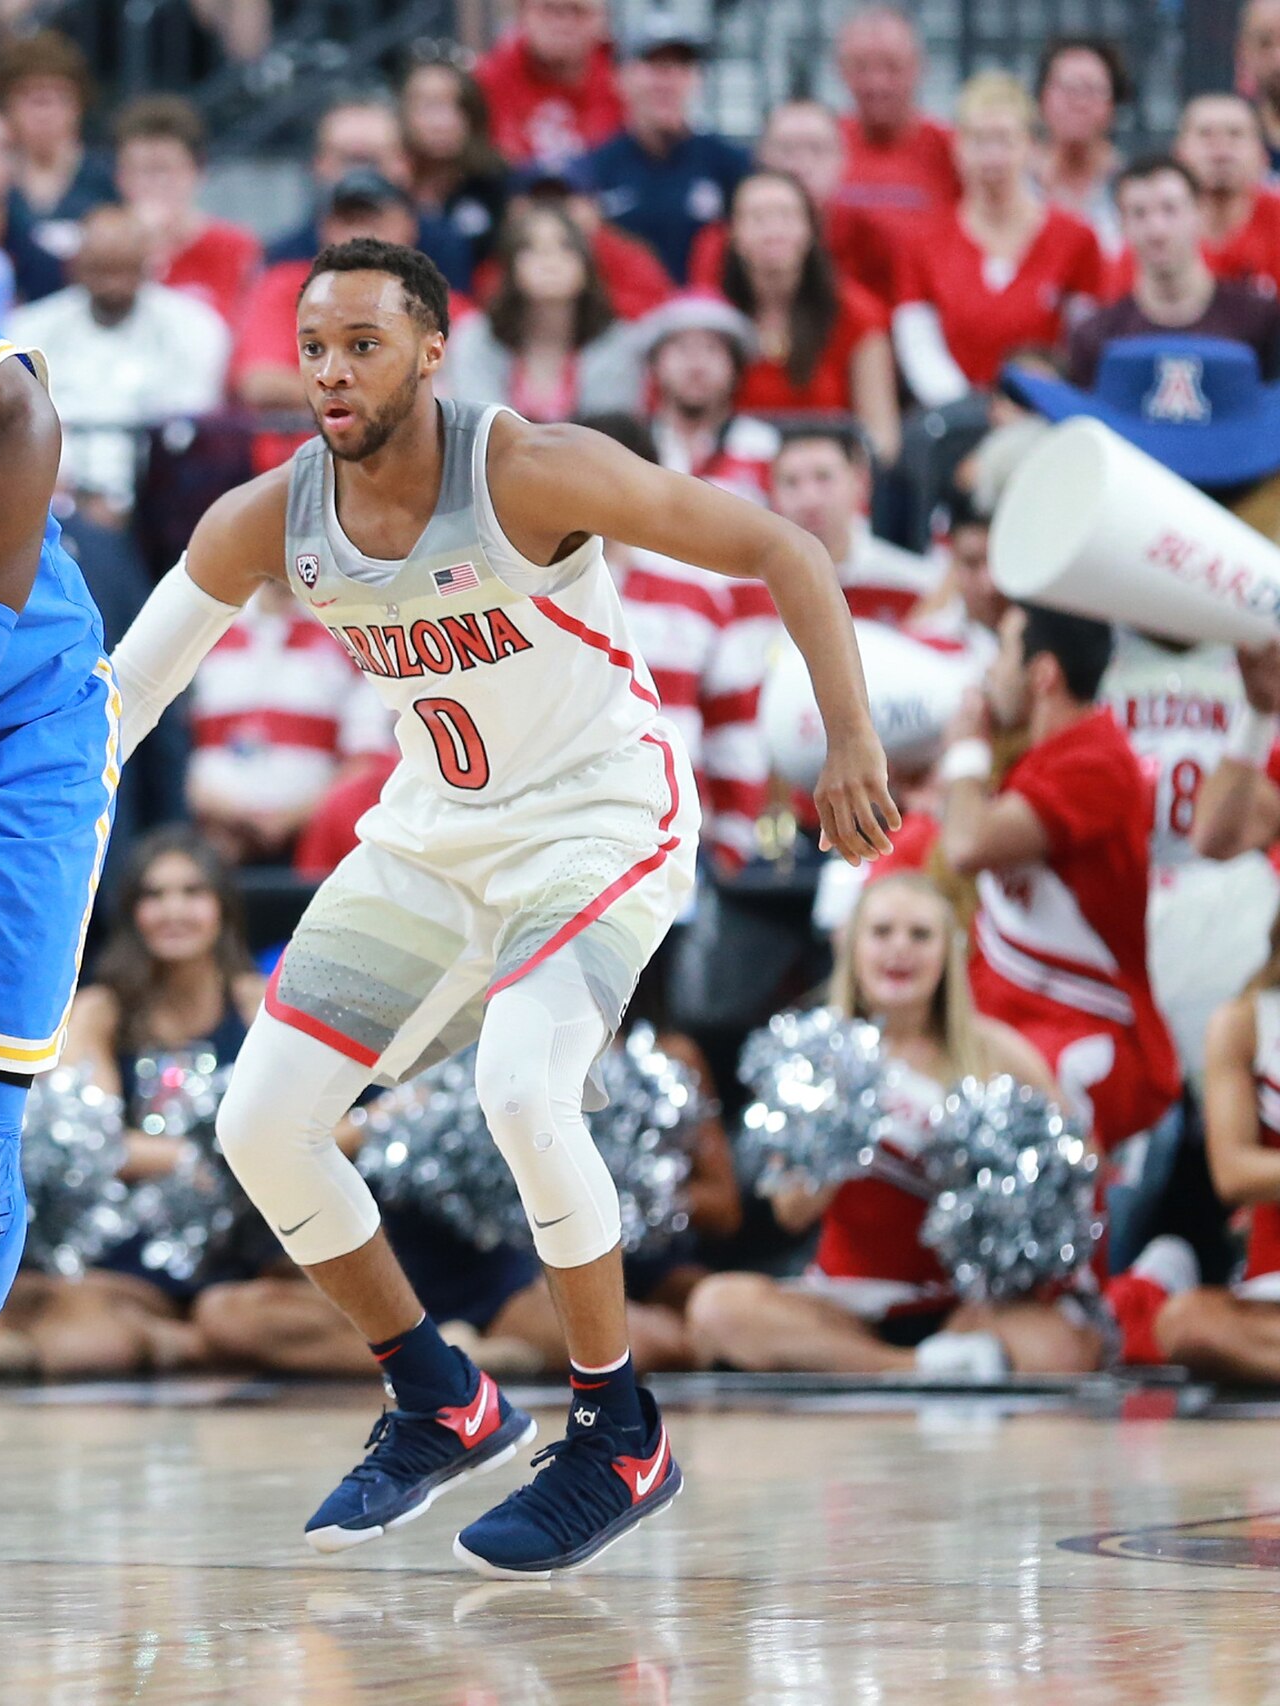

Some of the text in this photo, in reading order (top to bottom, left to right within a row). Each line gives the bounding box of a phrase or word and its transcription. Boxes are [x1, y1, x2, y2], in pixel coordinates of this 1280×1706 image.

[297, 556, 318, 575] PAC
[303, 569, 315, 583] 12
[328, 607, 534, 678] ARIZONA
[412, 697, 490, 790] 0
